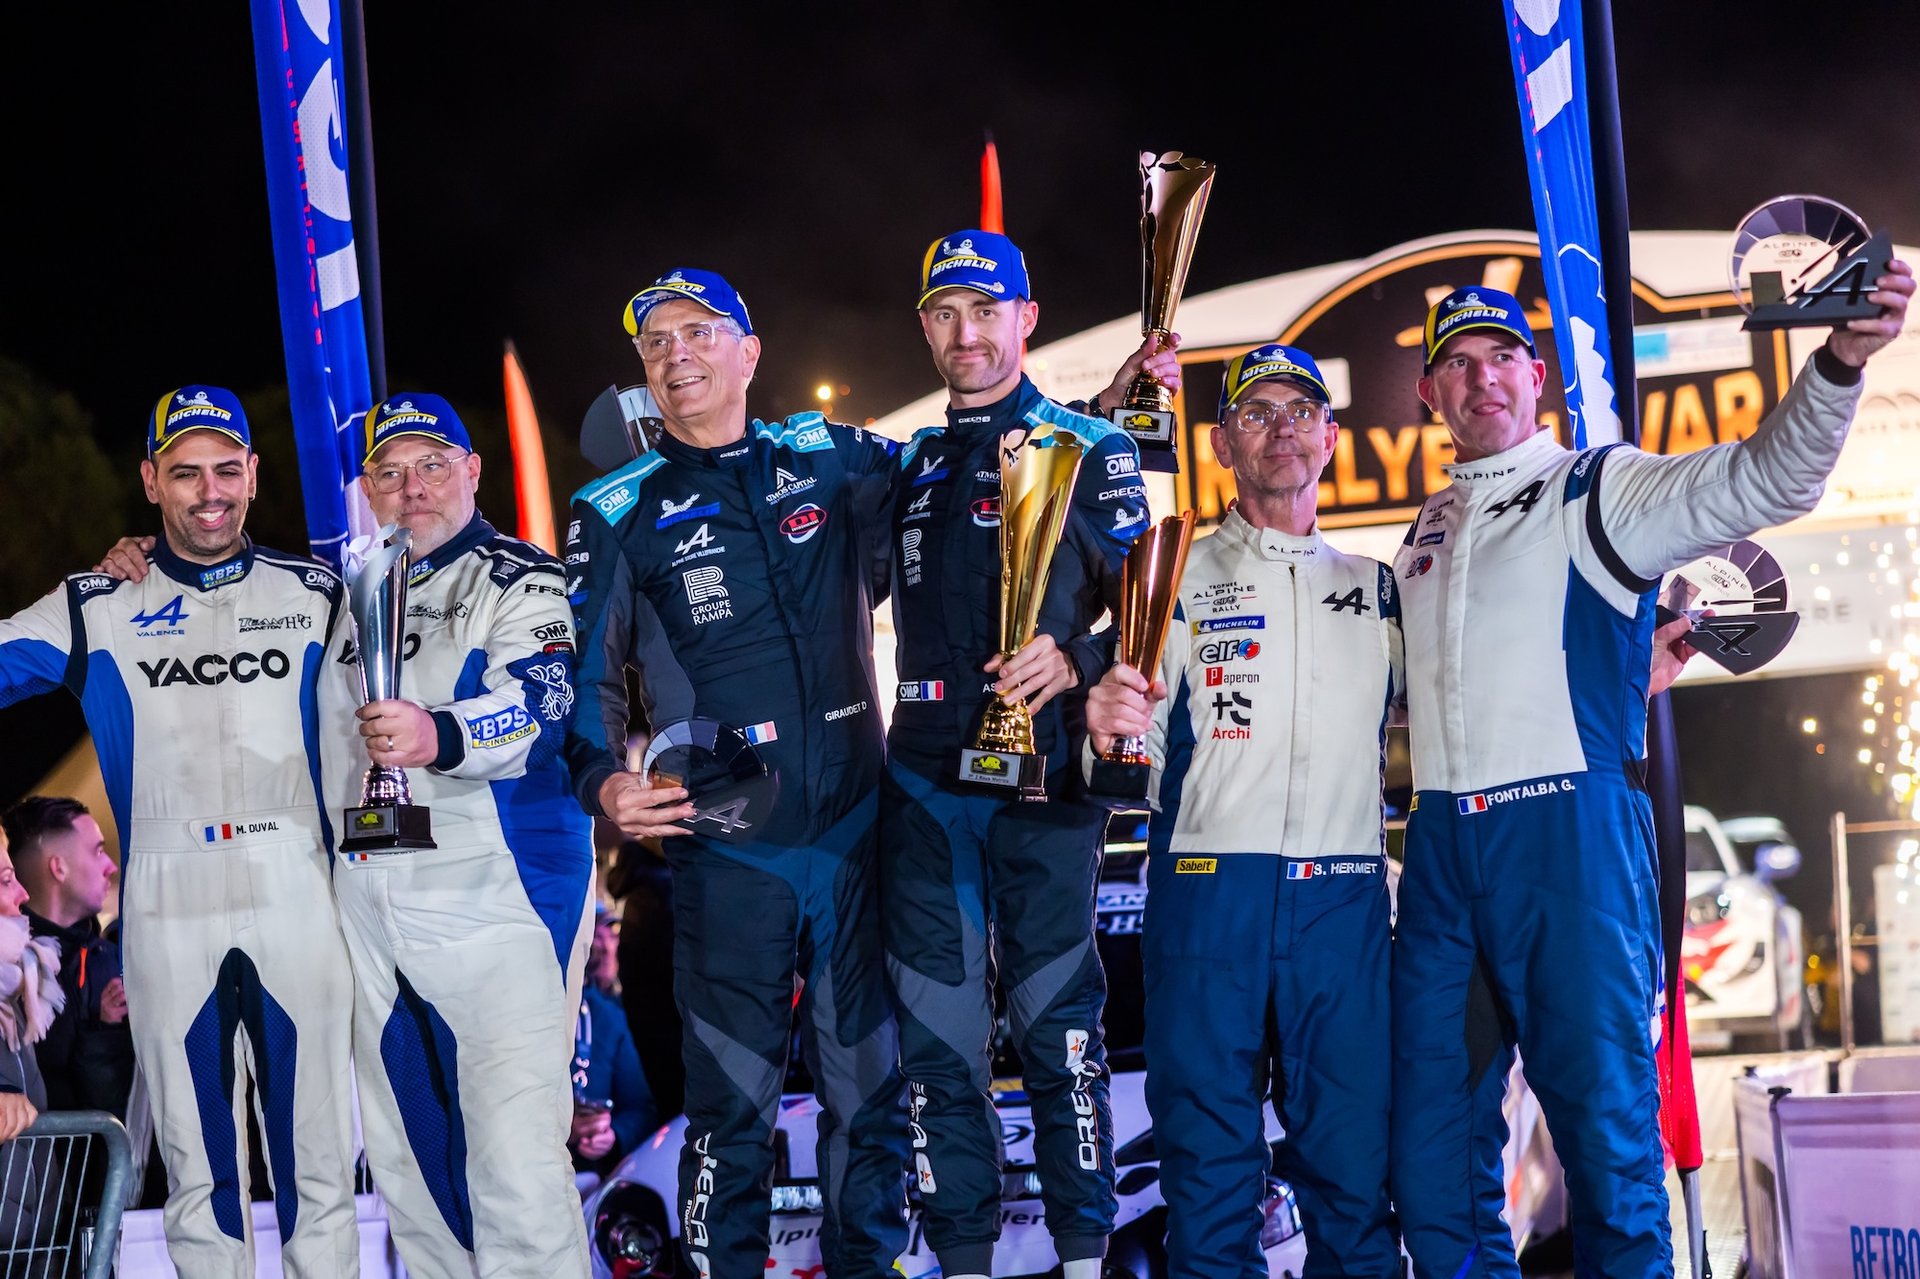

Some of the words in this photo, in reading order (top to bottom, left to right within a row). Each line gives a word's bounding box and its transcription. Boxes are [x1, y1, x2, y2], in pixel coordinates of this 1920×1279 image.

[1762, 241, 1818, 249] ALPINE
[931, 259, 997, 278] MICHELIN
[1437, 309, 1509, 335] MICHELIN
[167, 408, 231, 426] MICHELIN
[375, 415, 438, 438] MICHELIN
[796, 429, 827, 446] OMP
[1106, 457, 1136, 475] OMP
[765, 487, 788, 502] ATMOS
[788, 477, 818, 490] CAPITAL
[1099, 486, 1142, 501] ORECA
[600, 488, 630, 512] OMP
[214, 561, 243, 580] BPS
[1705, 561, 1747, 590] ALPINE
[78, 579, 111, 590] OMP
[306, 572, 336, 589] OMP
[1381, 567, 1393, 604] Sabelt
[1193, 585, 1256, 599] ALPINE
[691, 600, 731, 615] GROUPE
[1212, 605, 1240, 613] RALLY
[693, 609, 733, 626] RAMPA
[1213, 620, 1259, 629] MICHELIN
[136, 629, 185, 637] VALENCE
[239, 625, 283, 633] BONNETON
[534, 624, 568, 640] OMP
[1200, 640, 1241, 664] elf
[136, 648, 290, 688] YACCO
[900, 684, 920, 698] OMP
[825, 704, 861, 722] GIRAUDET
[861, 701, 867, 711] D
[480, 708, 528, 739] BPS
[1212, 727, 1250, 739] Archi
[1487, 782, 1558, 806] FONTALBA
[1561, 779, 1576, 791] G.
[236, 825, 247, 835] M.
[249, 821, 279, 833] DUVAL
[1179, 860, 1213, 871] Sabelt
[1313, 864, 1327, 875] S.
[1330, 863, 1378, 875] HERMET
